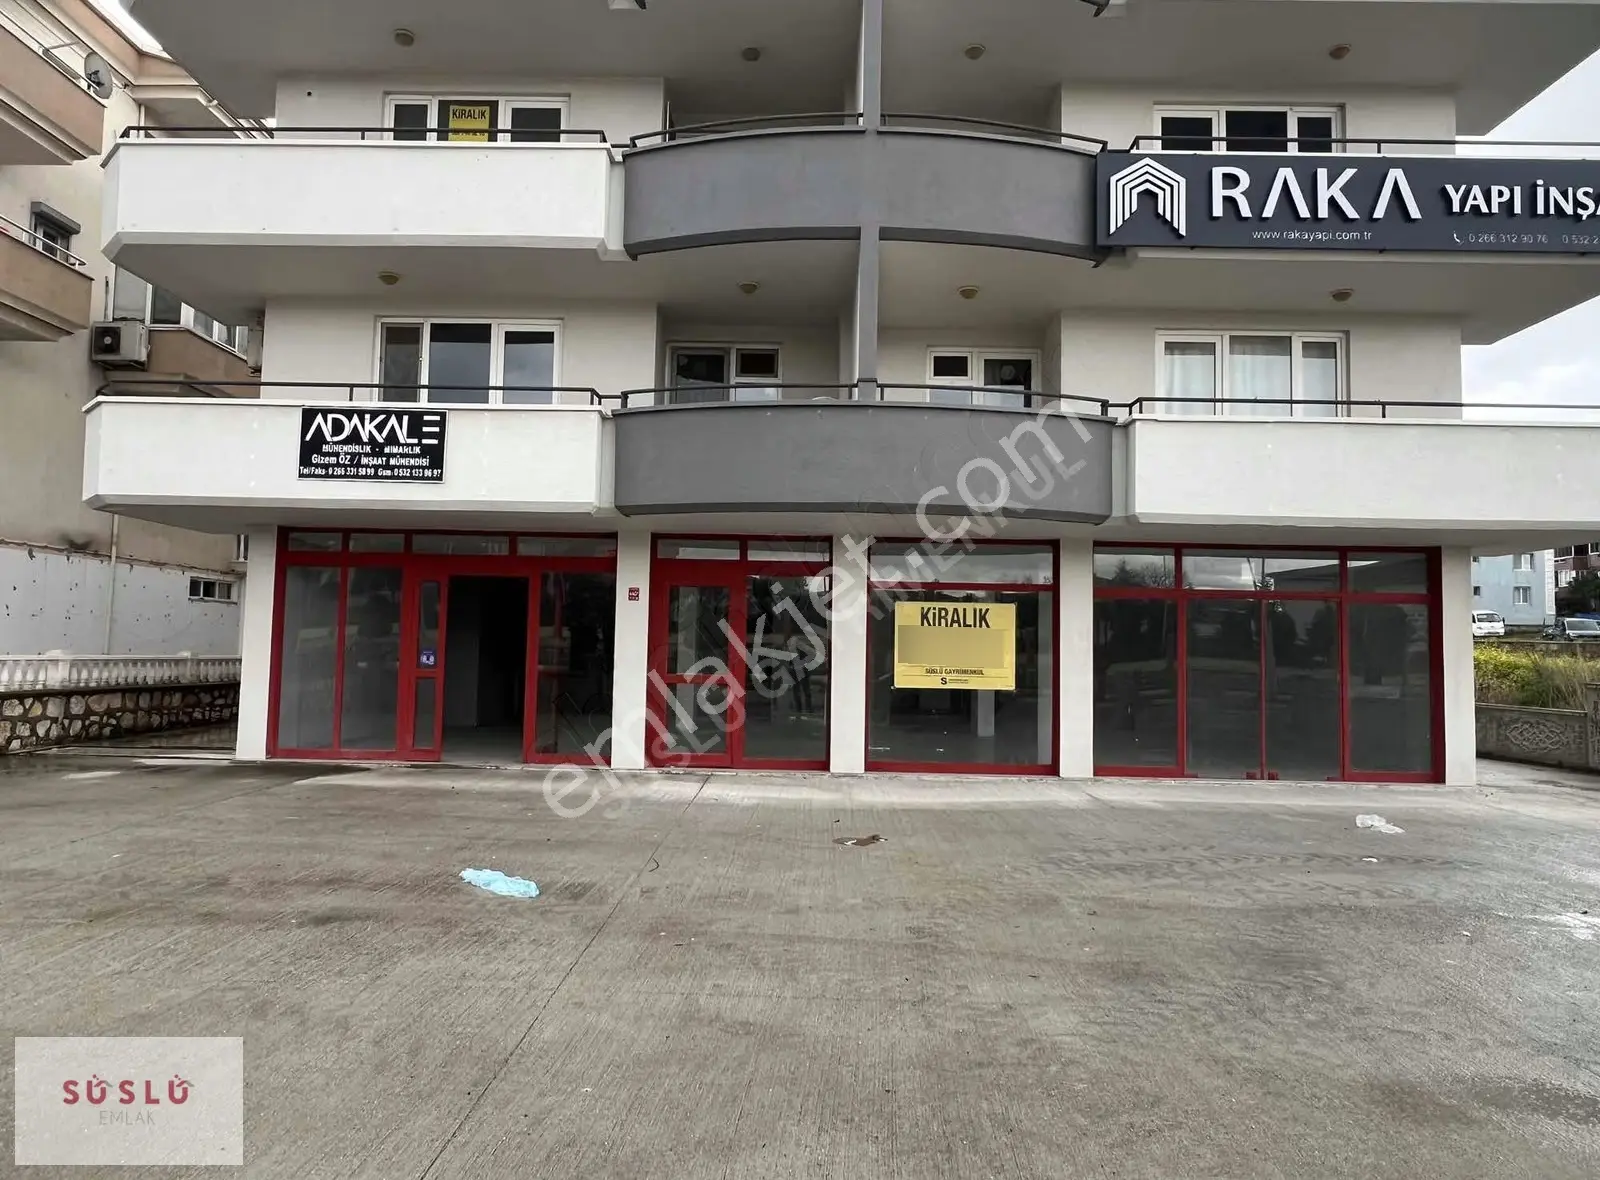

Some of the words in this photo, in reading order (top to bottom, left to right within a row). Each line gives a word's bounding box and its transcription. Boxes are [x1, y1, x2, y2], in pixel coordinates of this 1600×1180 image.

[1211, 165, 1423, 220] RAKA
[1443, 183, 1523, 216] YAPI
[1535, 178, 1600, 221] İNŞ
[1468, 233, 1476, 243] 0
[1477, 232, 1497, 244] 266
[1499, 233, 1518, 244] 312
[304, 411, 441, 445] ADAKALE
[338, 452, 352, 465] ÖZ
[360, 454, 387, 467] İNŞAAT
[389, 454, 430, 467] MÜHENDİSİ
[940, 677, 948, 685] S
